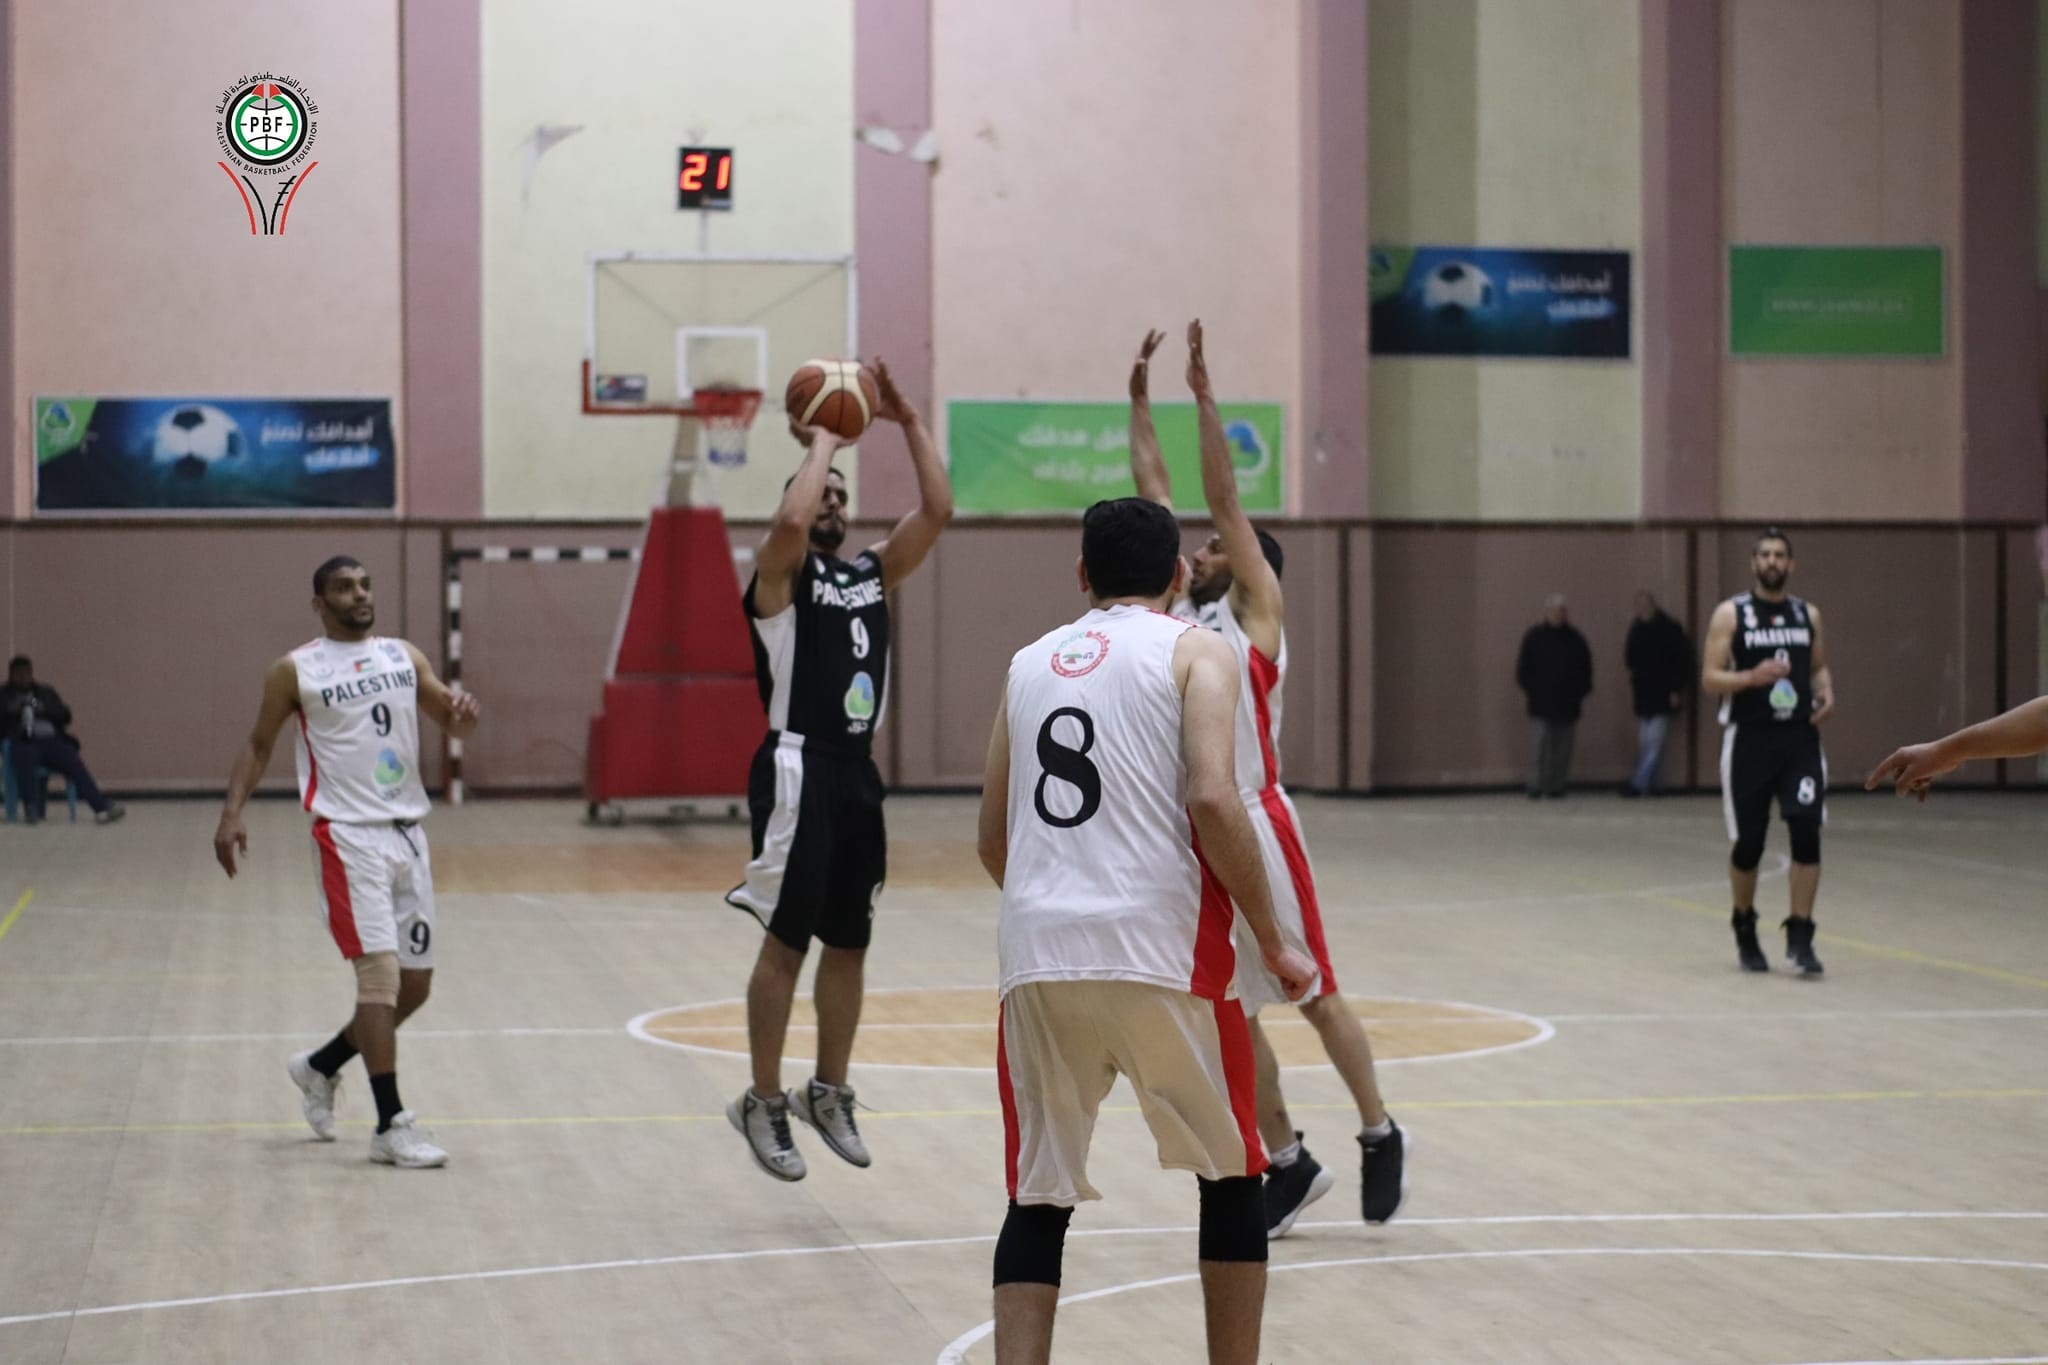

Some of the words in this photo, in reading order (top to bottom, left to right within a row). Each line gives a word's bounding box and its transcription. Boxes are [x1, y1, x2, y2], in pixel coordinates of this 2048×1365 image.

[679, 153, 731, 191] 21
[812, 577, 884, 609] PALESTINE
[849, 617, 870, 660] 9
[1744, 628, 1811, 648] PALESTINE
[321, 669, 415, 707] PALESTINE
[371, 703, 392, 737] 9
[1033, 706, 1102, 828] 8
[1797, 775, 1816, 806] 8
[409, 921, 431, 956] 9
